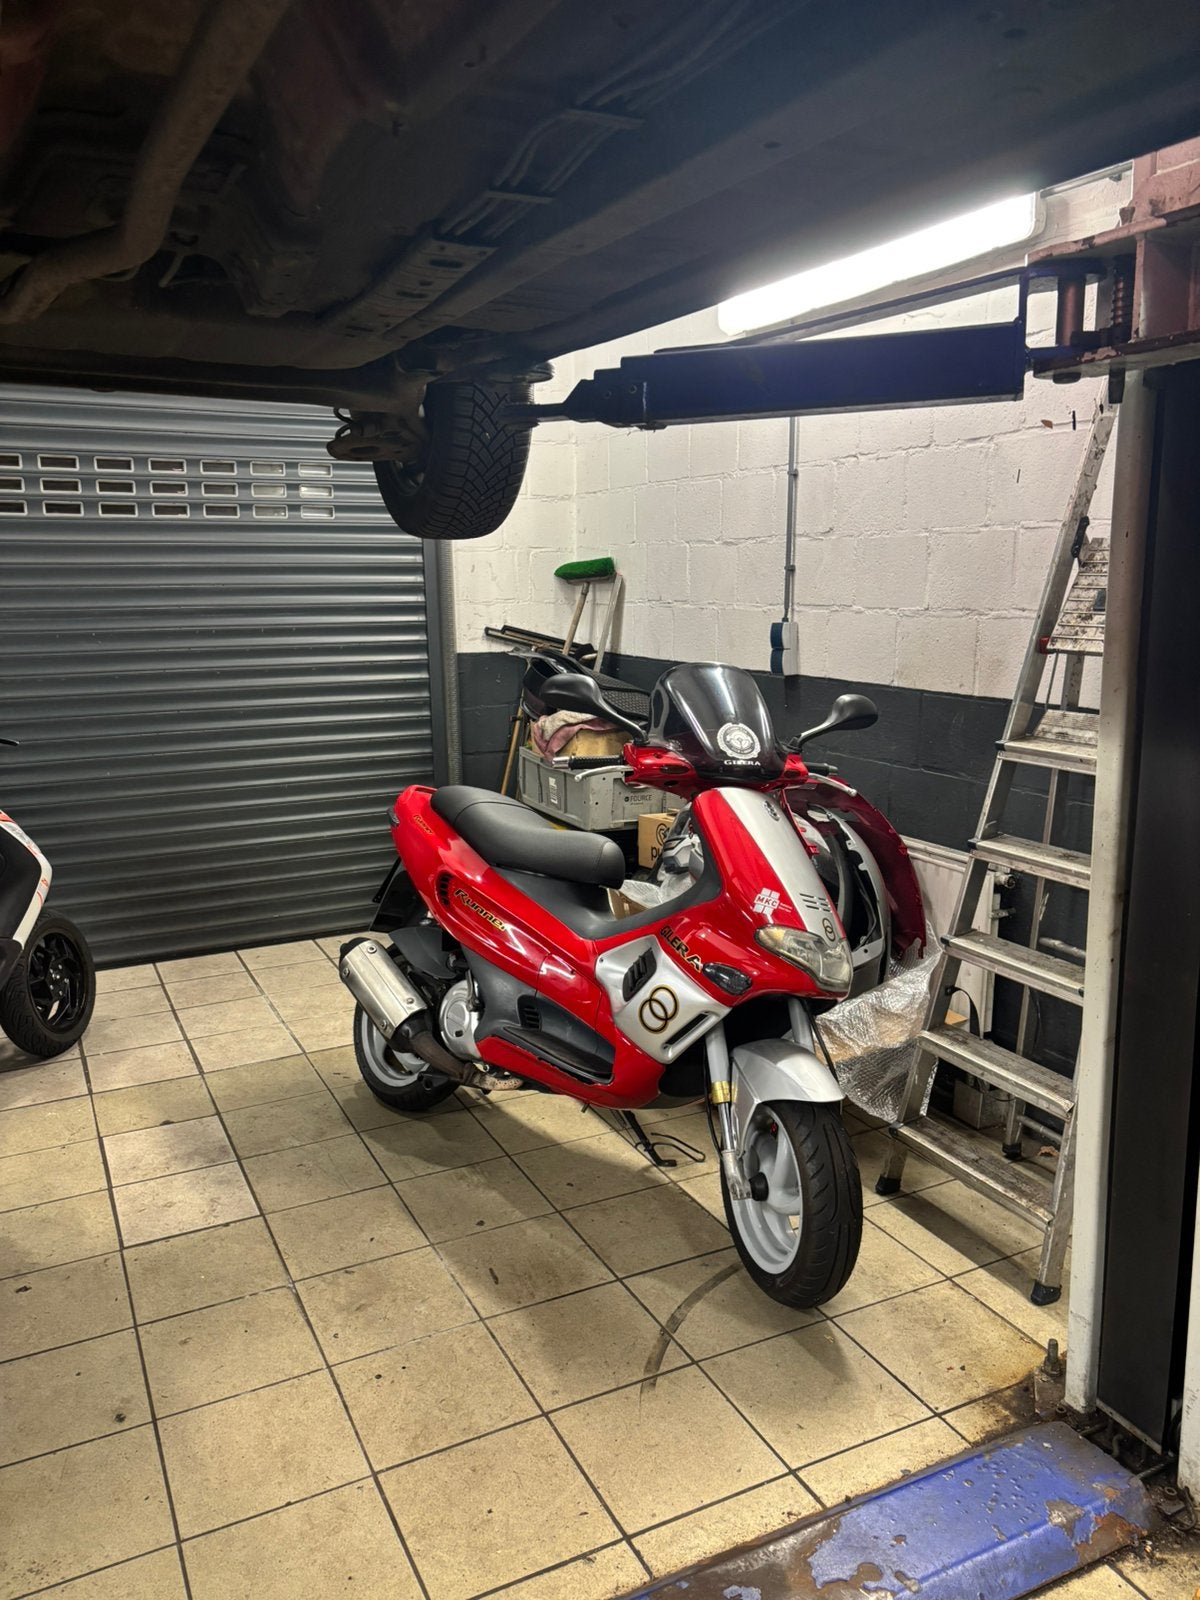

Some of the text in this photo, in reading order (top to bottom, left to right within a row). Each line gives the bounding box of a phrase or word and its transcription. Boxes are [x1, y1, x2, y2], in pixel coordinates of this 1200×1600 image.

[454, 888, 505, 932] Runner
[756, 895, 778, 907] MKC
[660, 925, 703, 973] GILERA
